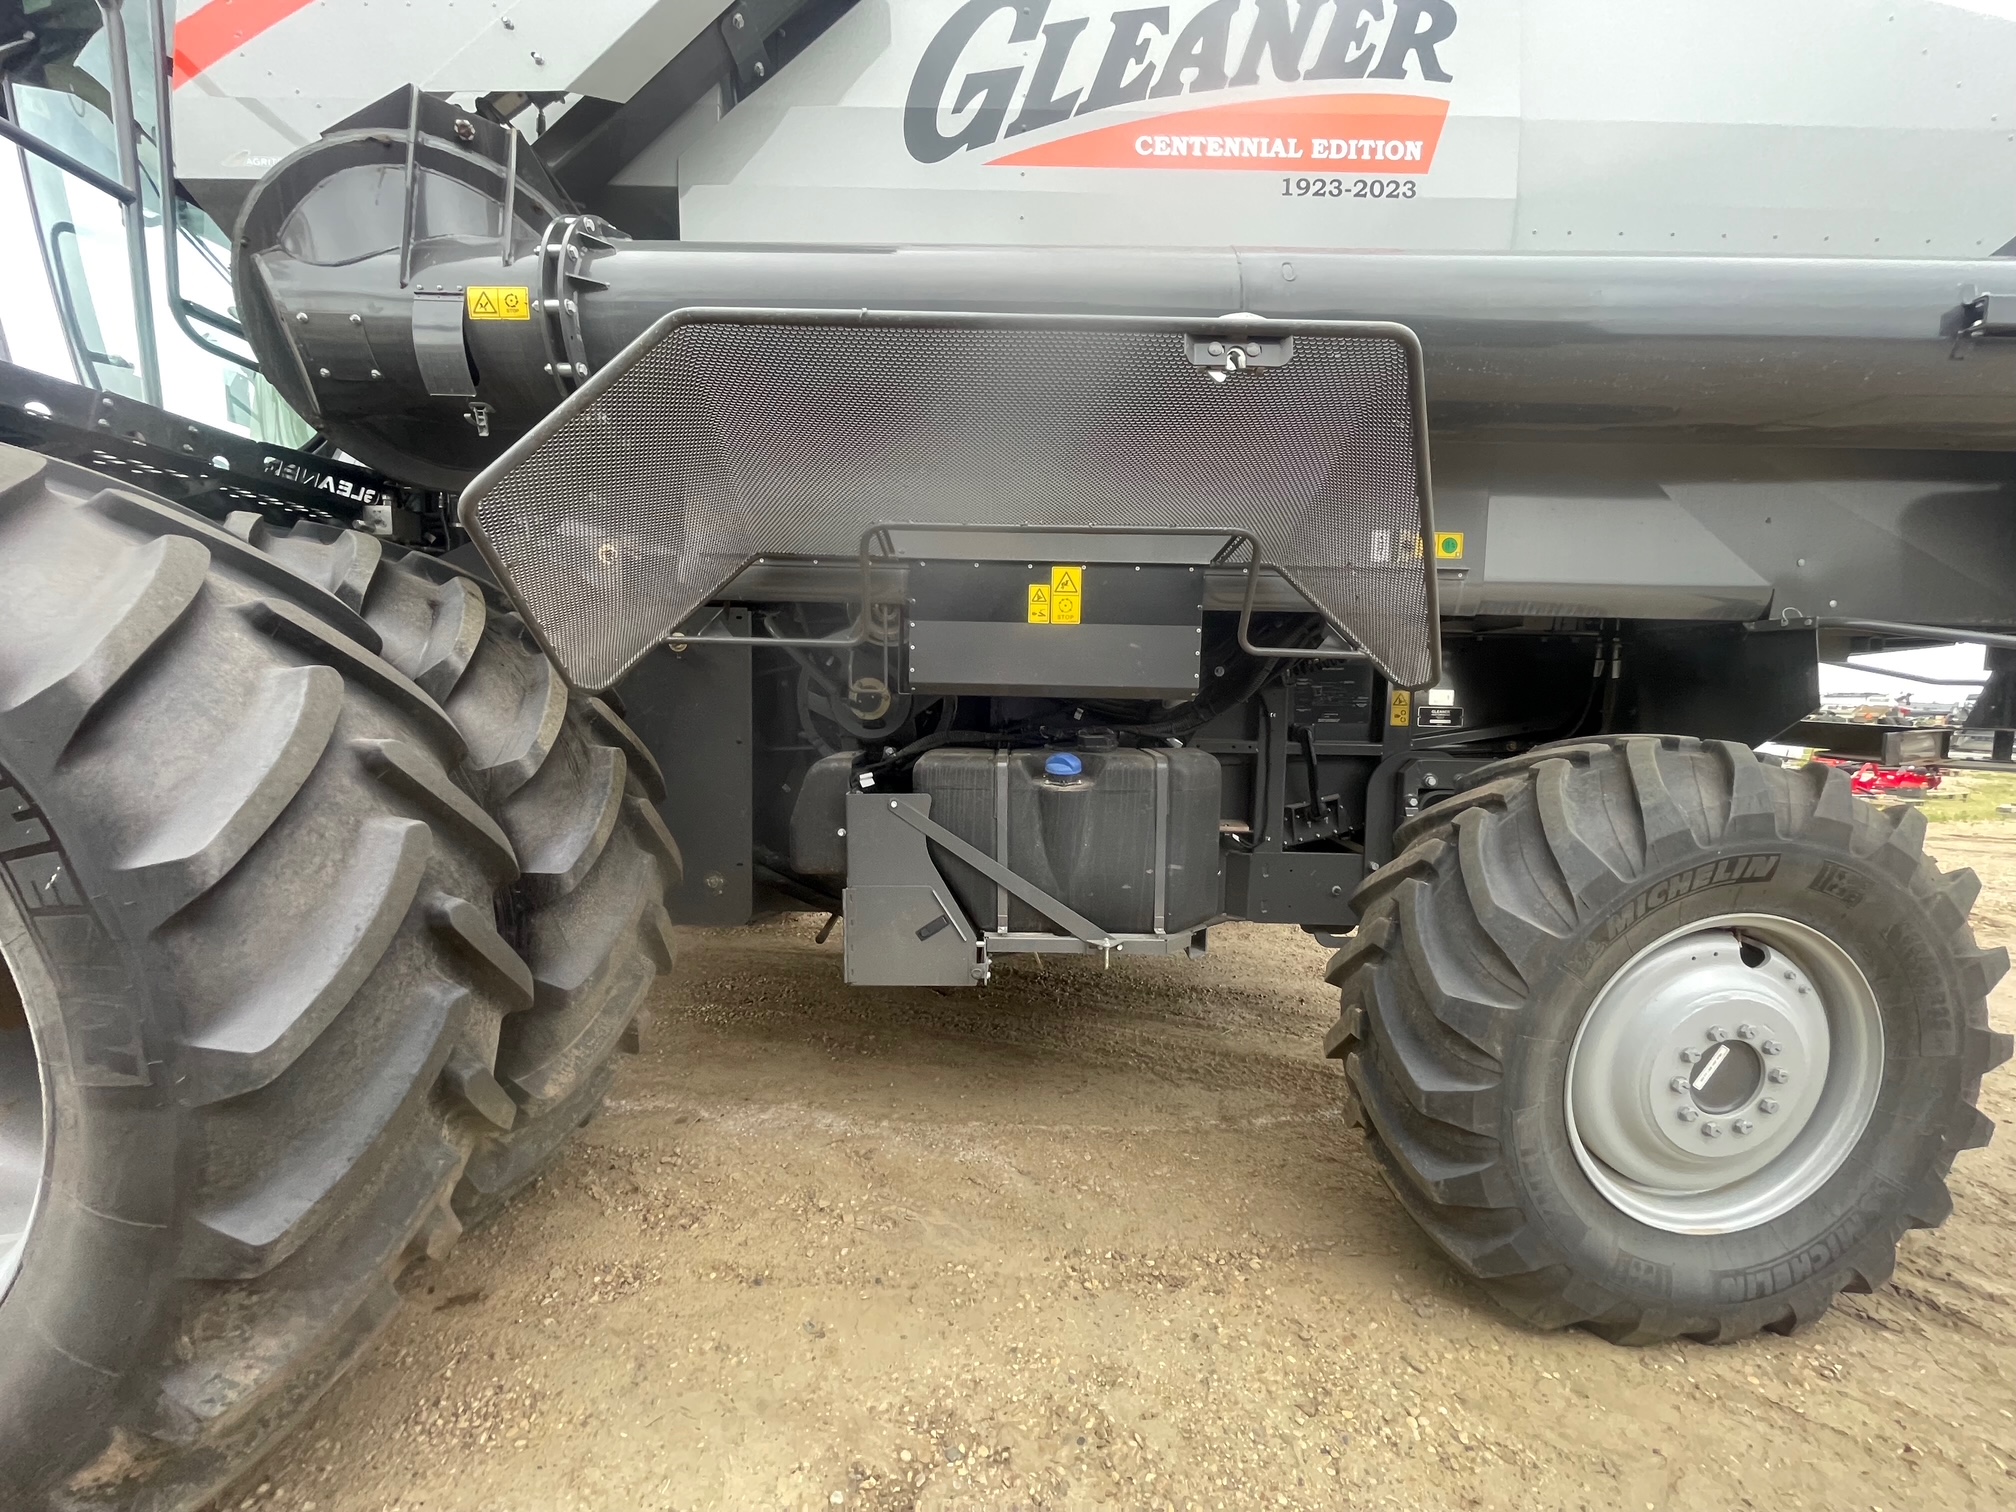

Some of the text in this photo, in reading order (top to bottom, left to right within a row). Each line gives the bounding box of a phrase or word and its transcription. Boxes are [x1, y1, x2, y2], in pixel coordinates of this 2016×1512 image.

[903, 0, 1458, 164] GLEANER
[1134, 136, 1423, 161] CENTENNIAL EDITION
[1281, 177, 1417, 199] 1923-2023
[1606, 854, 1780, 942] MICHELIN
